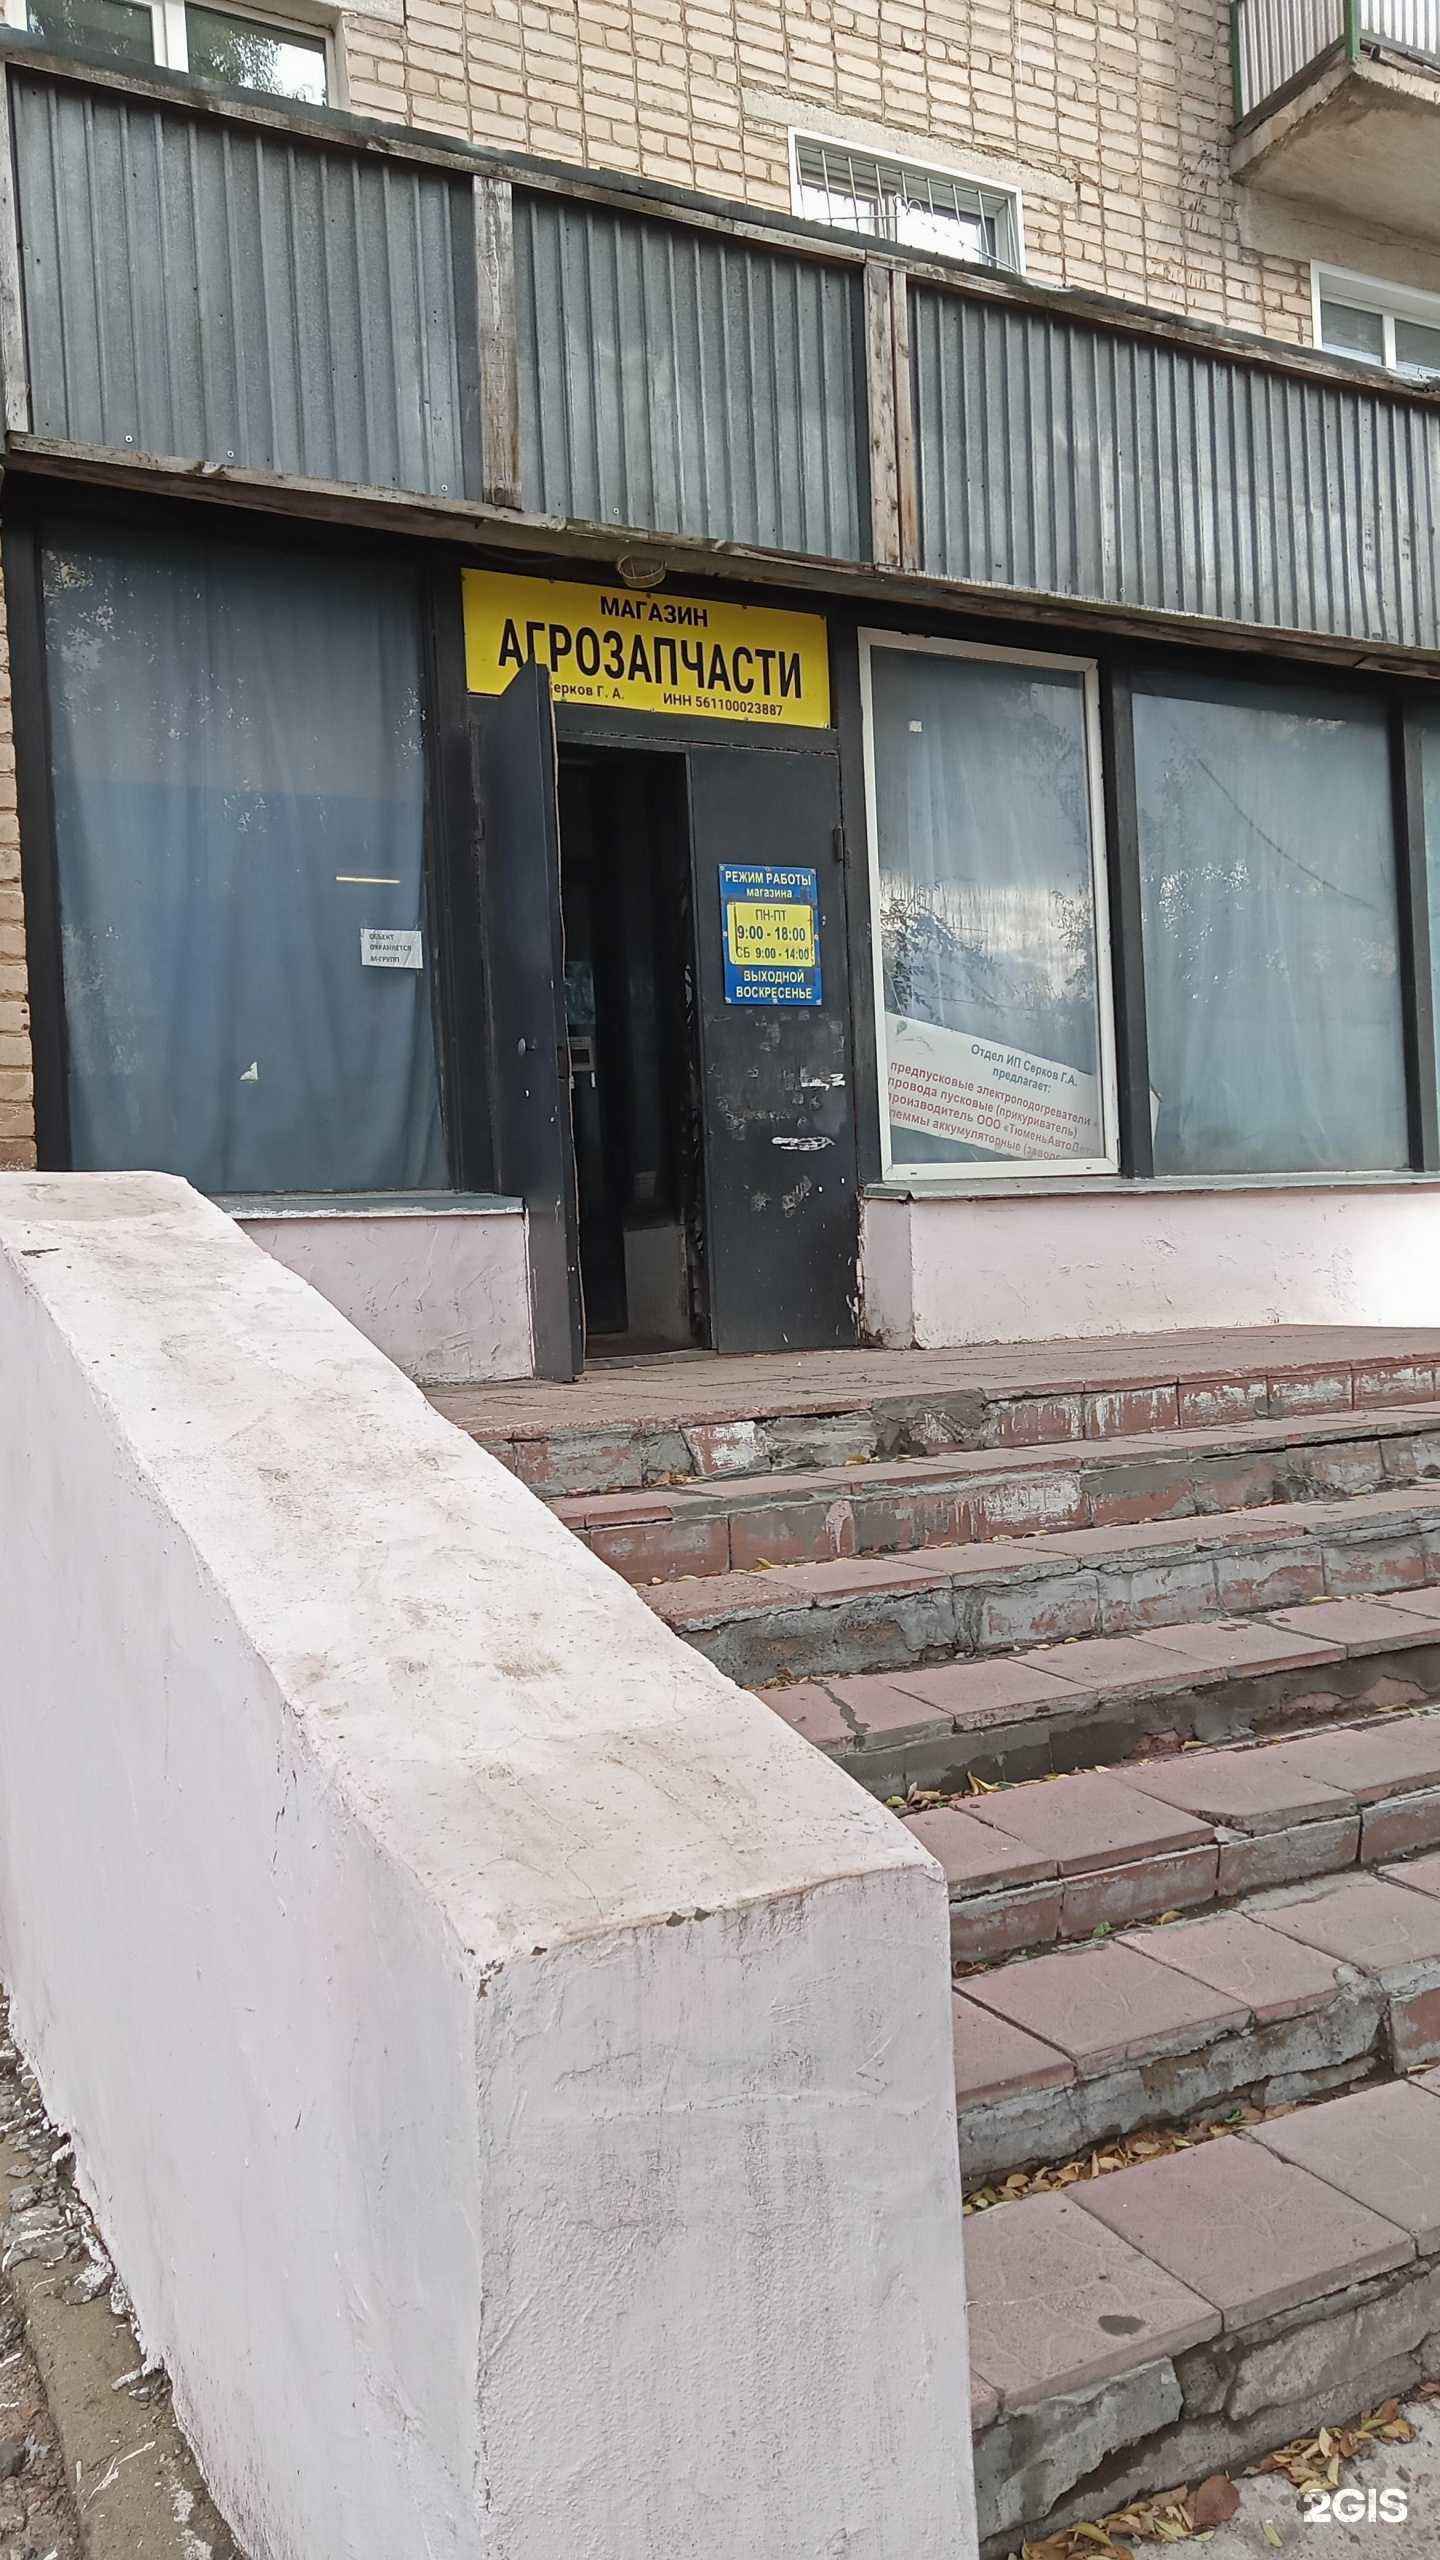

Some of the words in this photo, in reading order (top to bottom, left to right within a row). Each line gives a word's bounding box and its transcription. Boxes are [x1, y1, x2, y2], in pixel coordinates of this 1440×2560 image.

[600, 596, 709, 627] МАГАЗИН
[498, 618, 803, 699] АГРОЗАПЧАСТИ
[551, 683, 593, 697] ерков
[597, 685, 608, 698] Г.
[612, 687, 625, 700] А.
[663, 692, 692, 707] ИНН
[695, 695, 783, 716] 561100023887
[725, 871, 764, 884] РЕЖИМ
[766, 872, 812, 886] РАБОТЫ
[746, 888, 793, 898] магазина
[755, 909, 787, 921] ПН-ПТ
[737, 925, 764, 940] 9:00
[774, 926, 806, 942] 18:00
[736, 947, 750, 959] СБ
[755, 949, 776, 959] 9:00
[785, 949, 810, 960] 14:00
[743, 969, 805, 984] ВЫХОДНОЙ
[736, 986, 813, 999] ВОСКРЕСЕНЬЕ
[971, 1043, 1004, 1063] Отдел
[1006, 1053, 1022, 1069] ИП
[1023, 1060, 1058, 1081] Серков
[890, 1062, 974, 1092] предпусковые
[976, 1085, 1091, 1126] электроподогреватели
[888, 1076, 938, 1098] провода
[940, 1091, 994, 1113] пусковые
[996, 1104, 1078, 1139] (прикуриватель)
[976, 1114, 1001, 1130] ООО
[932, 1119, 1021, 1152] аккумуляторные
